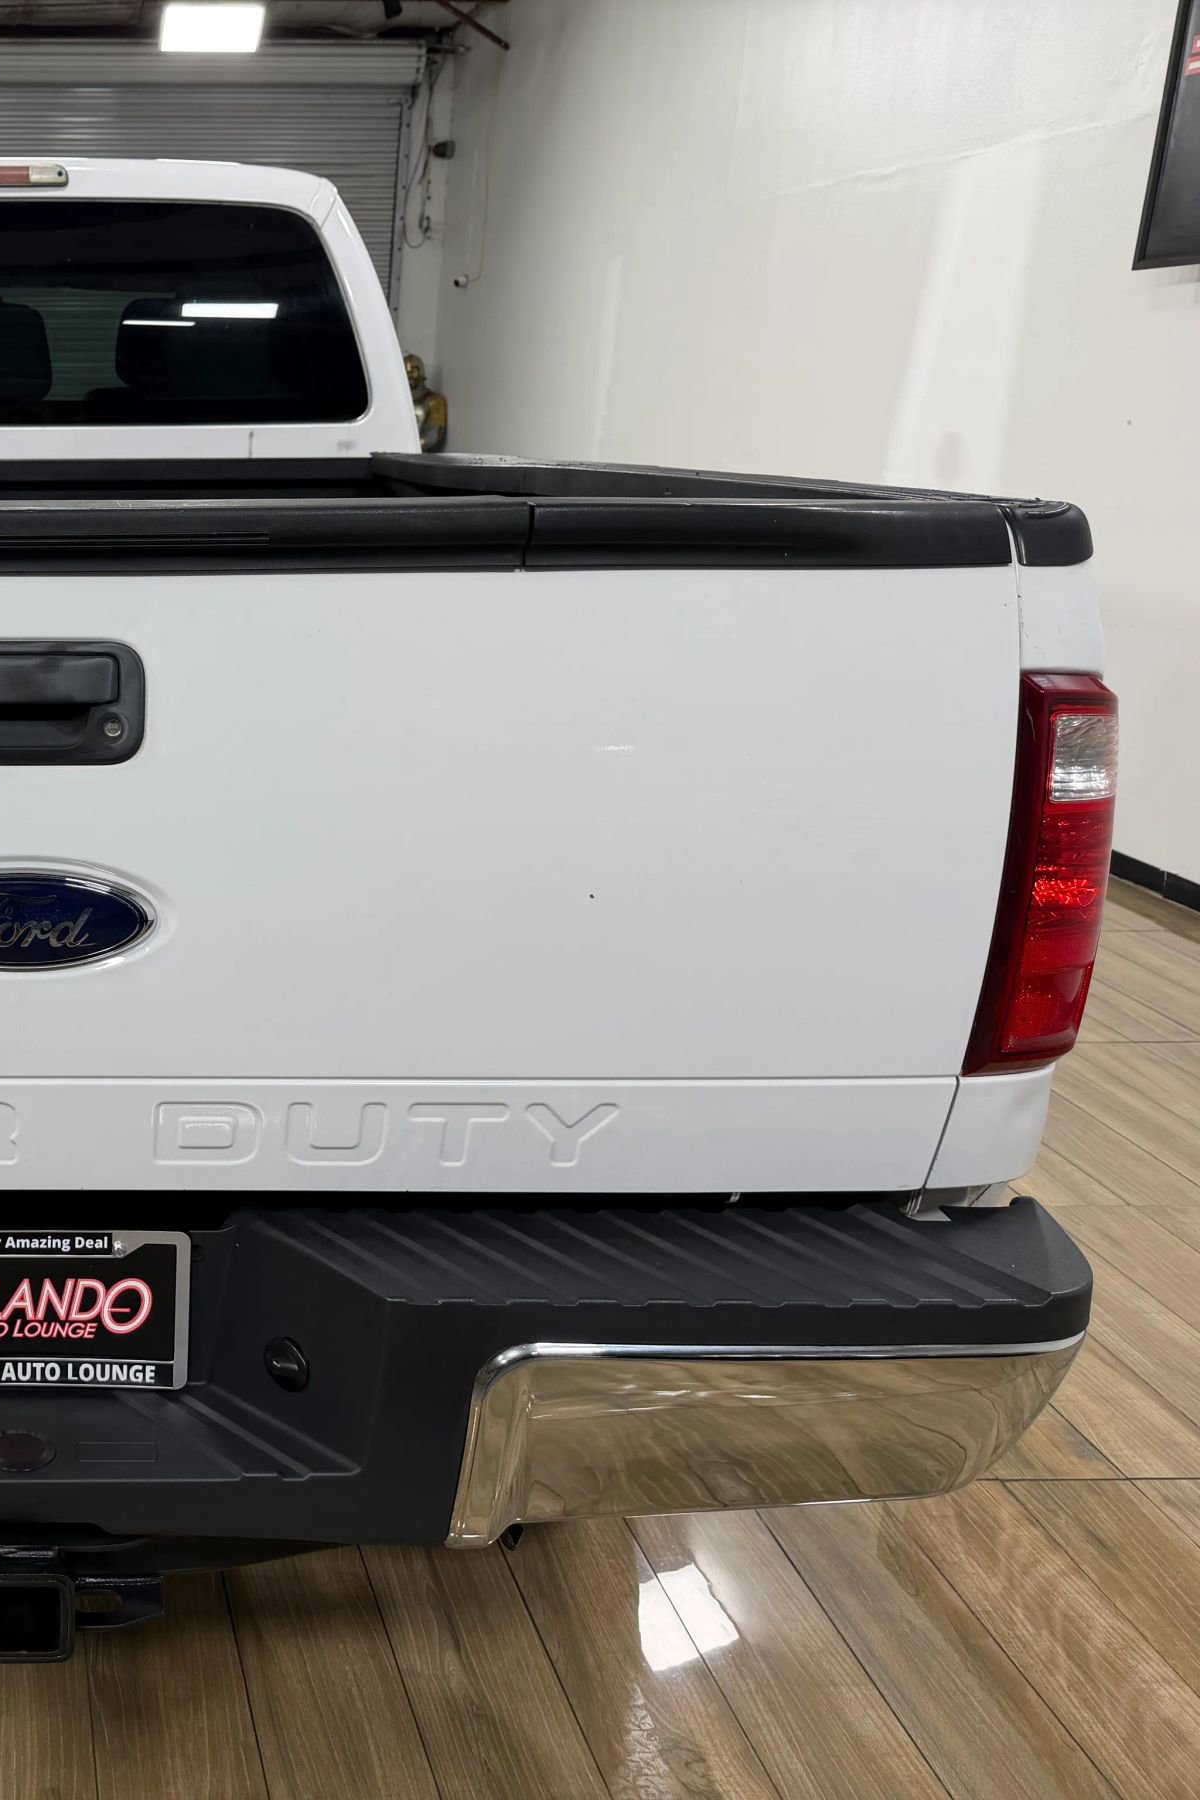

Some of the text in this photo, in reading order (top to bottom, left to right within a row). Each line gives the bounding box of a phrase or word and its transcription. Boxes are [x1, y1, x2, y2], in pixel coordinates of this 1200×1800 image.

[152, 1101, 620, 1168] DUTY
[5, 1236, 70, 1251] Amazing
[75, 1236, 108, 1249] Deal
[11, 1319, 99, 1339] LOUNGE
[1, 1362, 61, 1382] AUTO
[67, 1364, 156, 1384] LOUNGE
